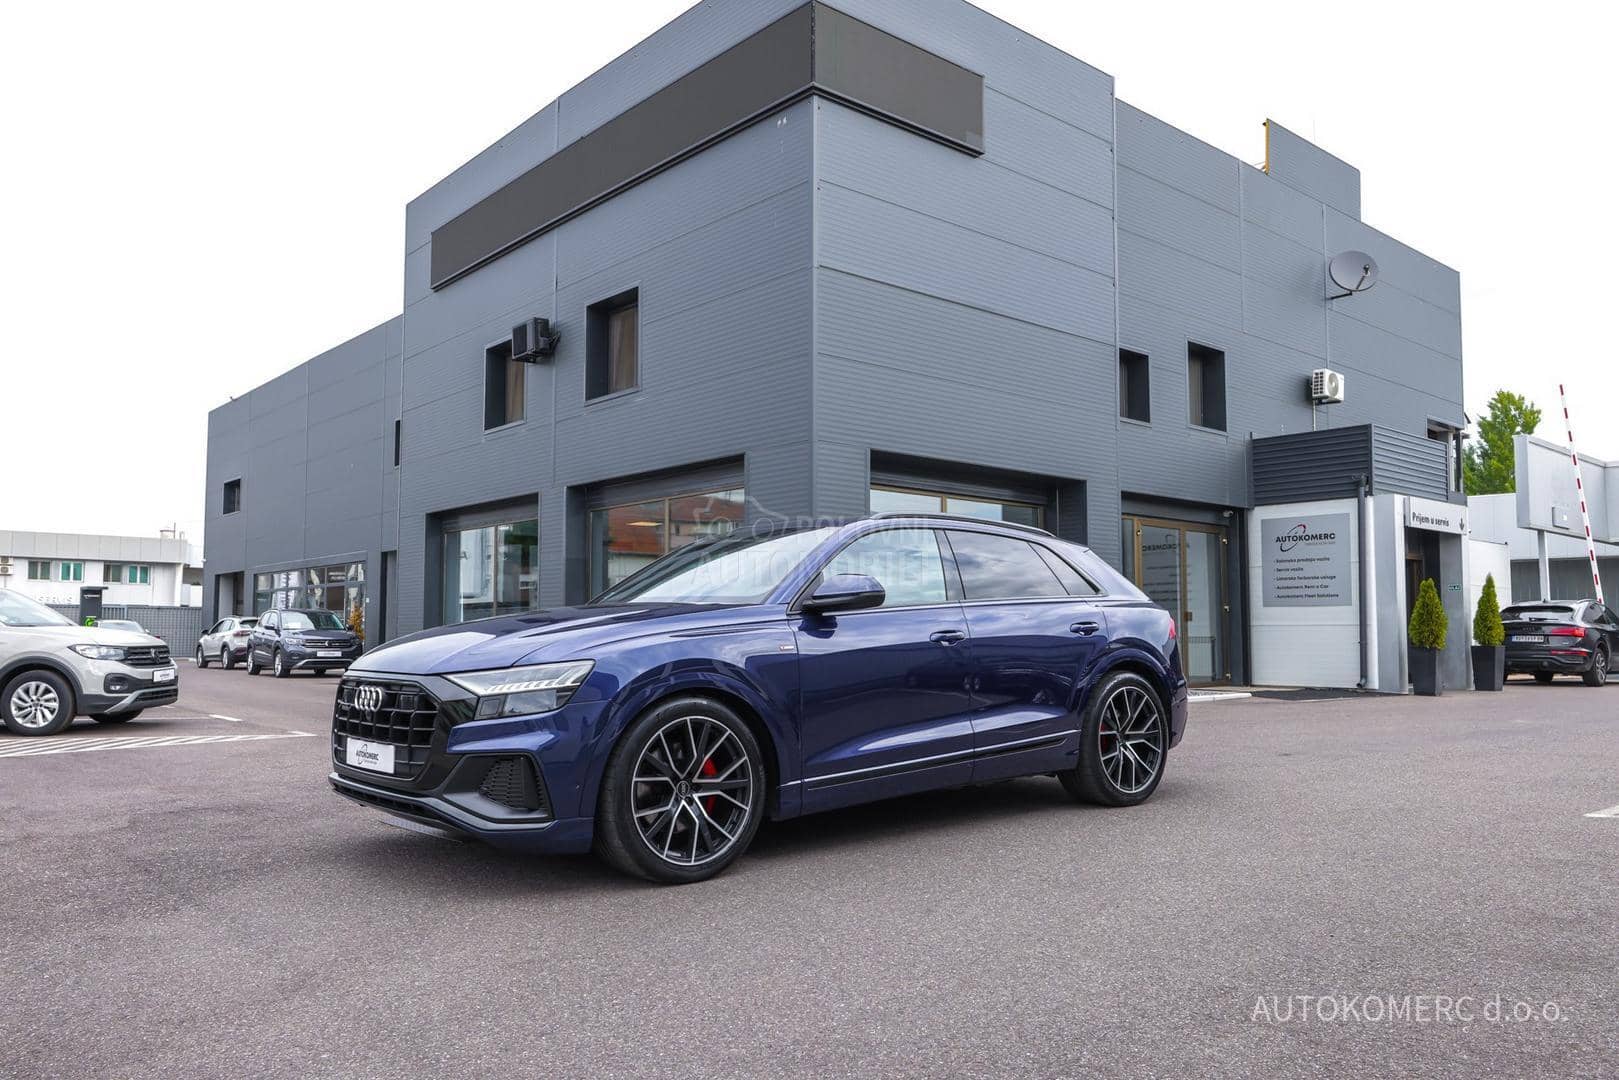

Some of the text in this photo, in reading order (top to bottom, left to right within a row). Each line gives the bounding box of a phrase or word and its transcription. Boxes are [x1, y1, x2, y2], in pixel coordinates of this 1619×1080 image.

[1412, 511, 1430, 525] Prijem
[1435, 518, 1449, 527] servis
[1275, 533, 1336, 543] AUTOKOMERC
